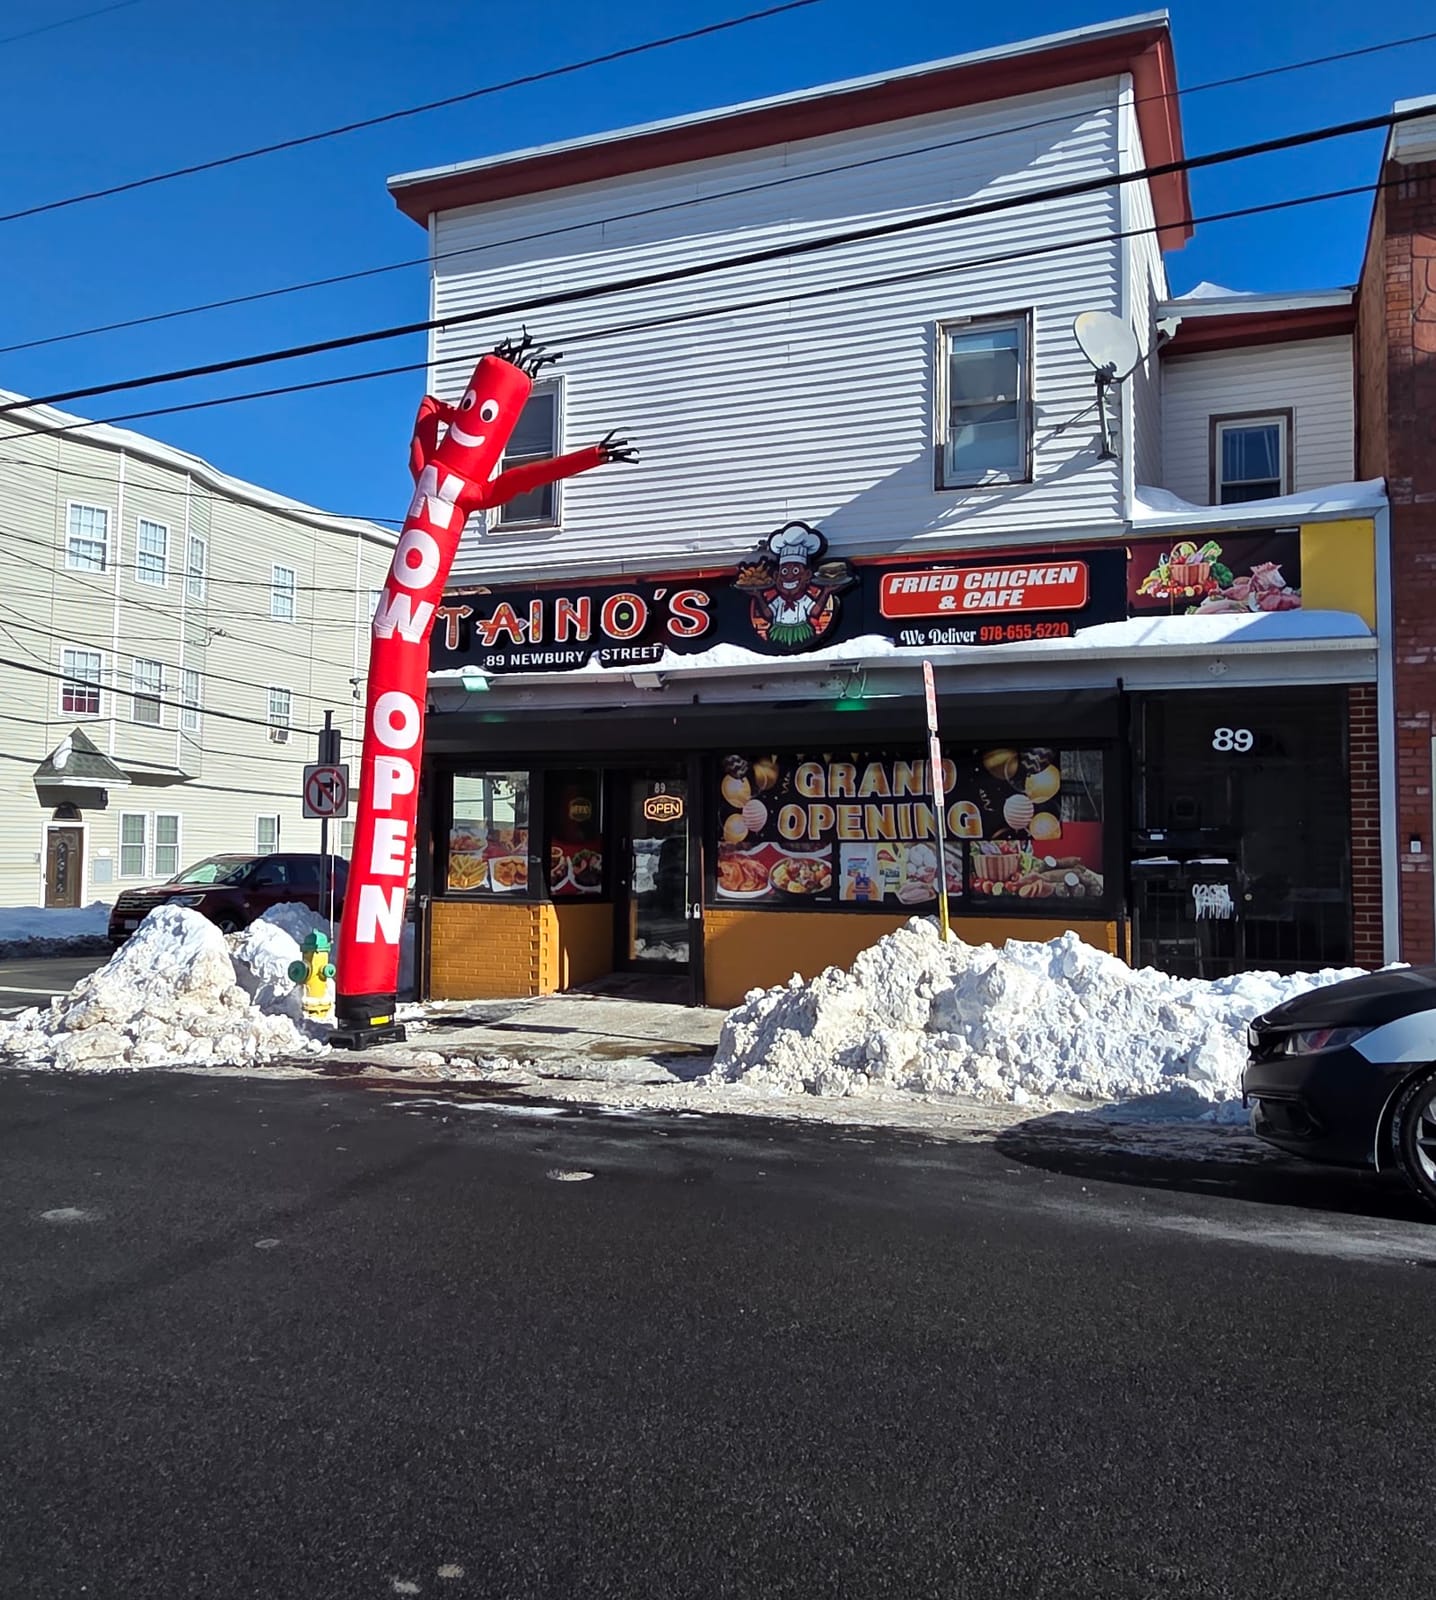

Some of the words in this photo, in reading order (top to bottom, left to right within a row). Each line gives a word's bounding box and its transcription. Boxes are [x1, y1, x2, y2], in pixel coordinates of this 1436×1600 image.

[374, 464, 465, 644] NOW
[889, 574, 959, 594] FRIED
[963, 566, 1078, 590] CHICKEN
[938, 596, 957, 610] &
[963, 589, 1025, 608] CAFE
[436, 588, 710, 649] TAINO'S
[900, 630, 925, 645] We
[928, 628, 976, 645] Deliver
[980, 622, 1069, 641] 978-655-5220
[486, 655, 505, 666] 89
[510, 651, 585, 666] NEWBURY
[601, 646, 661, 660] STREET
[1212, 727, 1254, 752] 89
[654, 782, 666, 793] 89
[795, 758, 957, 798] GRAND
[356, 691, 420, 945] OPEN
[647, 803, 680, 815] OPEN
[777, 801, 983, 840] OPENING
